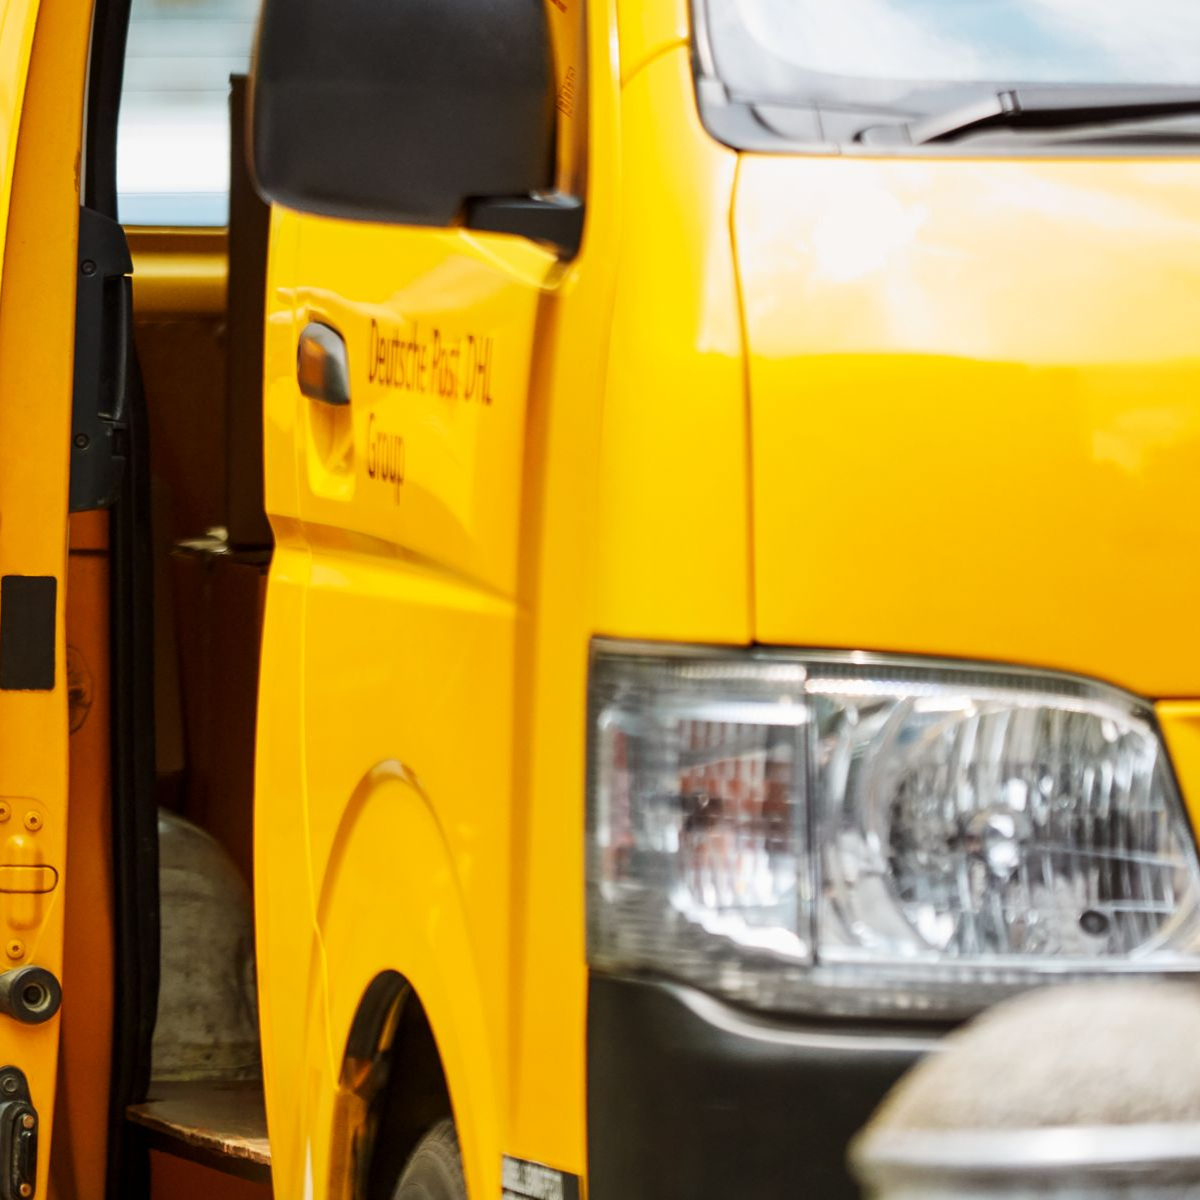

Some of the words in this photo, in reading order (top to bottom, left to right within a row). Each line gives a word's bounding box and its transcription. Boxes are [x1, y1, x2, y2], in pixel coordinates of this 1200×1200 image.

[368, 318, 427, 394] Deutsche
[431, 328, 460, 400] Post
[464, 335, 493, 406] DHL
[367, 412, 405, 506] Group
